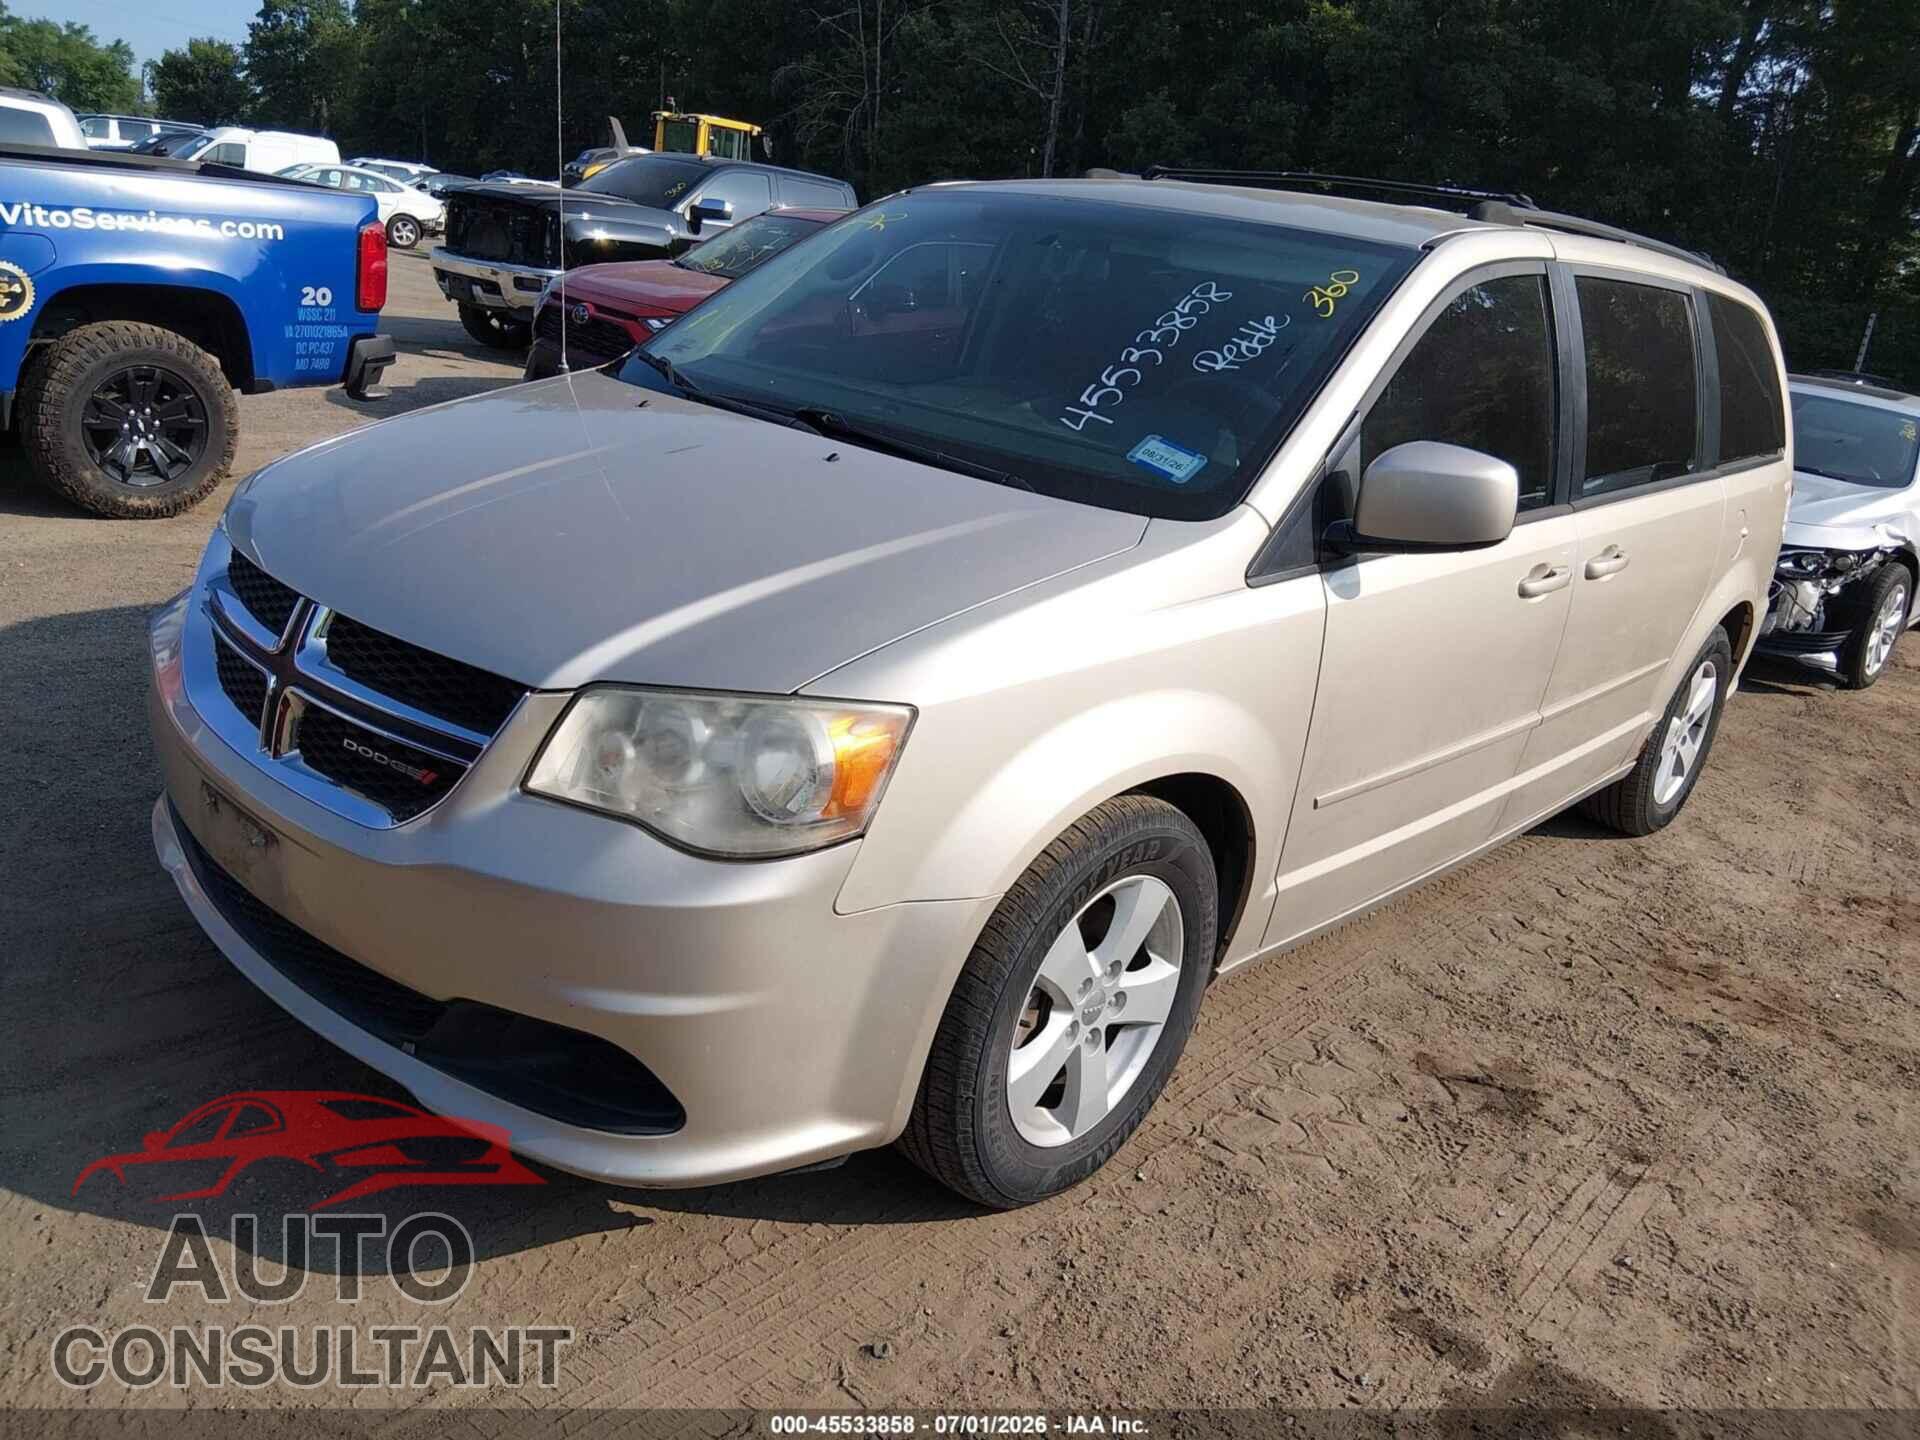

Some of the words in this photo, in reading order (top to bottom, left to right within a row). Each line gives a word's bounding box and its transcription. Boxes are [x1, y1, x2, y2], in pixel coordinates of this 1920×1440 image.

[301, 286, 332, 306] 20
[324, 308, 336, 321] 211
[1303, 270, 1360, 318] 360
[1060, 281, 1233, 431] 45533858
[343, 738, 420, 782] DODGE
